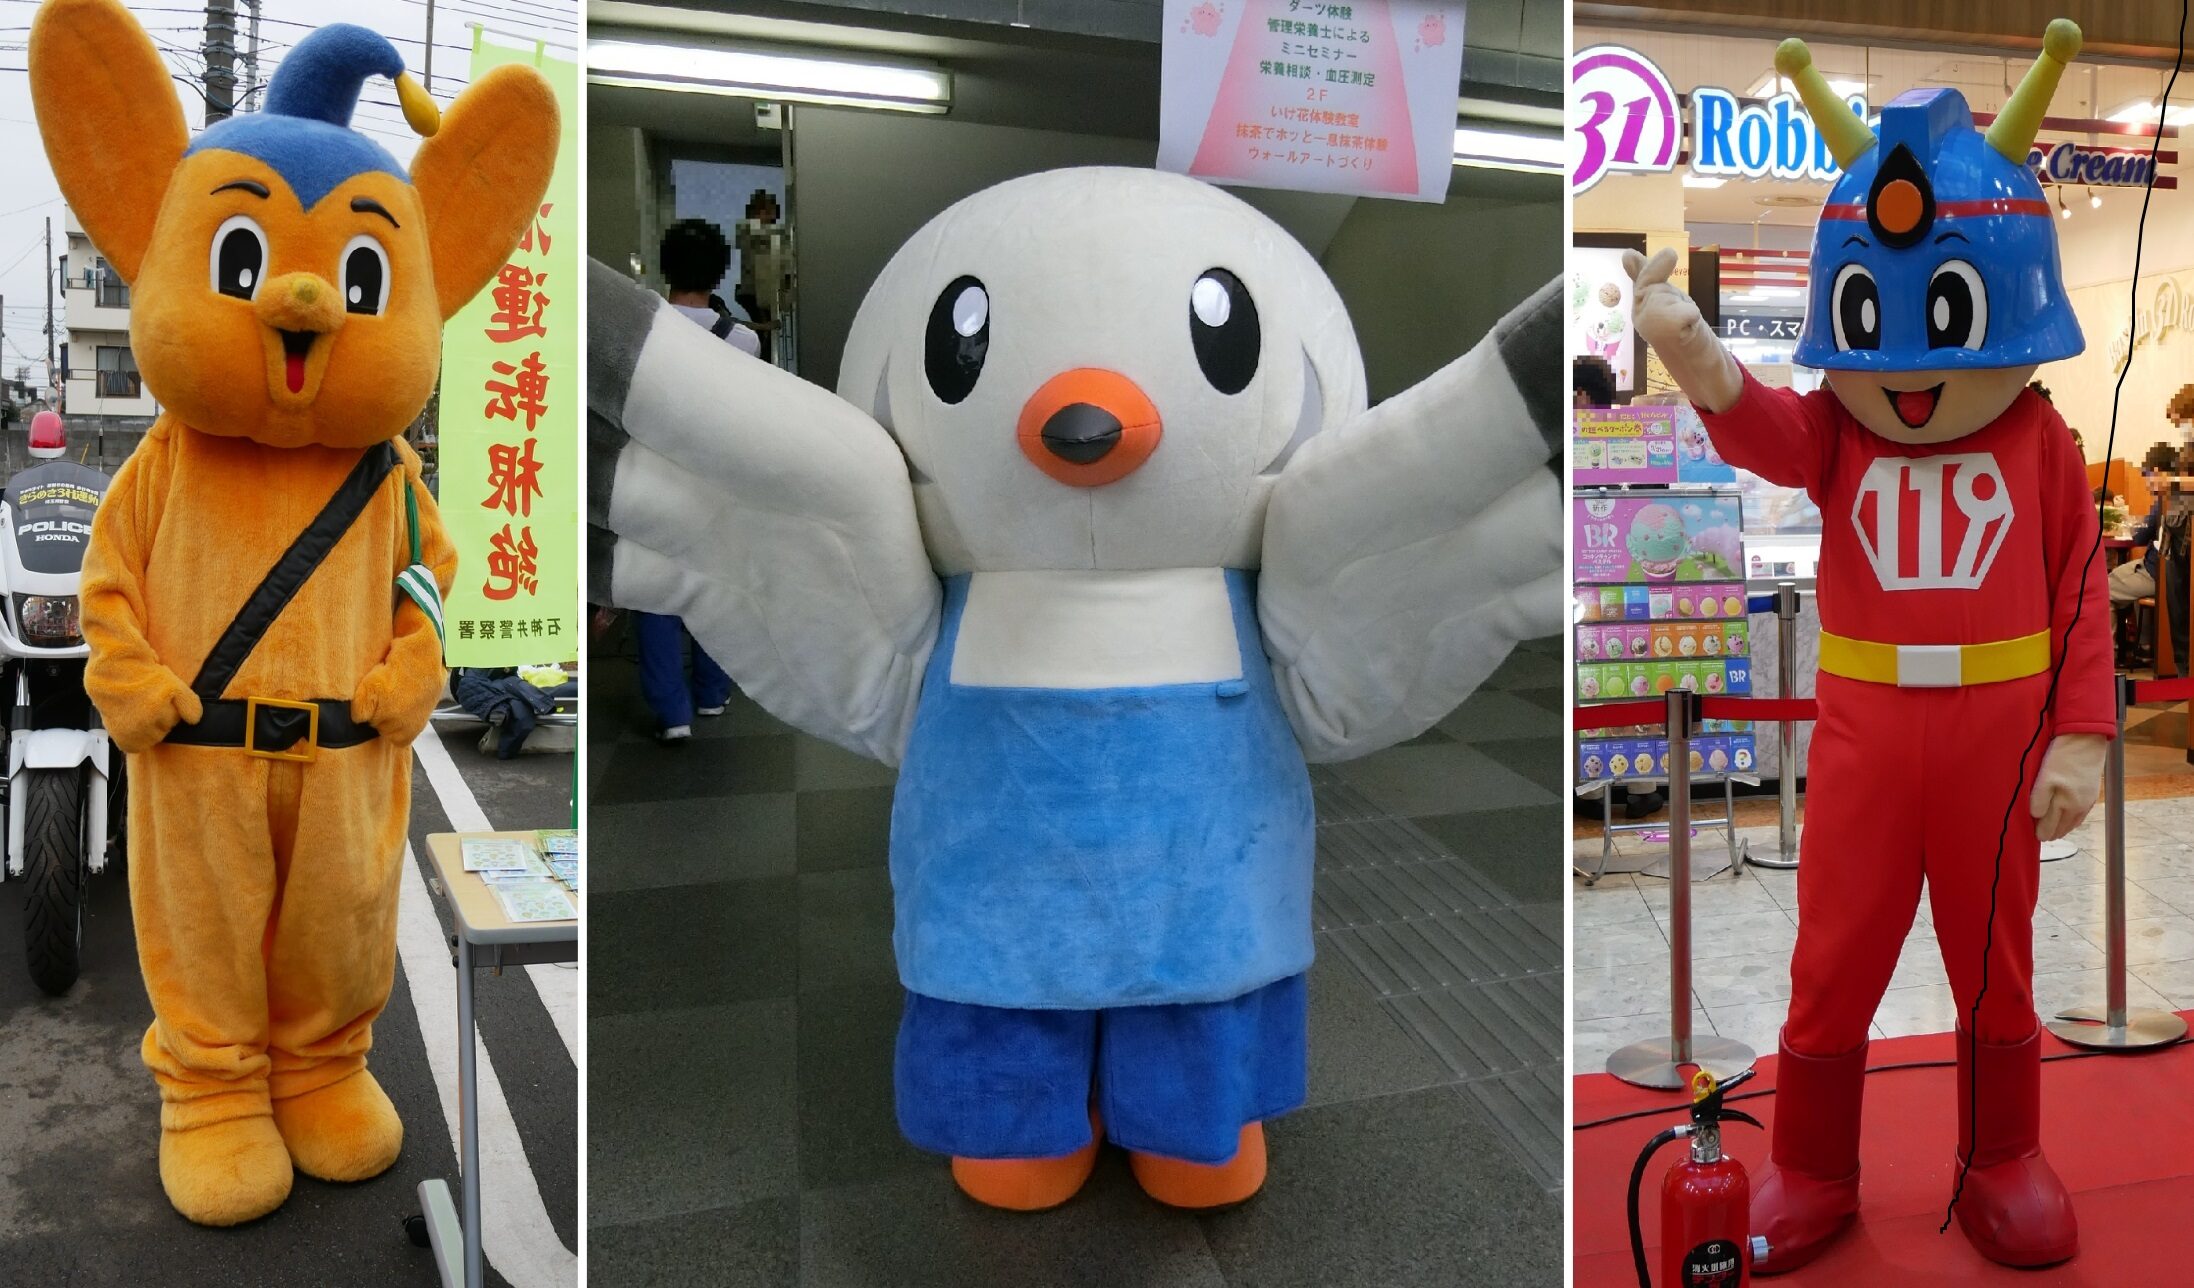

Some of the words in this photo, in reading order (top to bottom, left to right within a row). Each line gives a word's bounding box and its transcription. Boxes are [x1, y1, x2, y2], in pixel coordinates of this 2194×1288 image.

[1288, 0, 1352, 20] ダーツ体験
[1267, 17, 1370, 44] 管理栄養士による
[1281, 41, 1358, 61] ミニセミナー
[1259, 60, 1376, 87] 栄養相談・血圧測定
[1271, 105, 1360, 128] いけ花体験教室
[1236, 123, 1388, 151] 抹茶でホッと一息抹茶体験
[1573, 91, 1651, 186] 31
[1248, 148, 1373, 171] ウォールアートづくり
[2049, 143, 2156, 185] Cream
[18, 520, 92, 535] POLICE
[1854, 454, 2012, 589] 119
[35, 534, 80, 543] HONDA
[1729, 670, 1747, 683] BR
